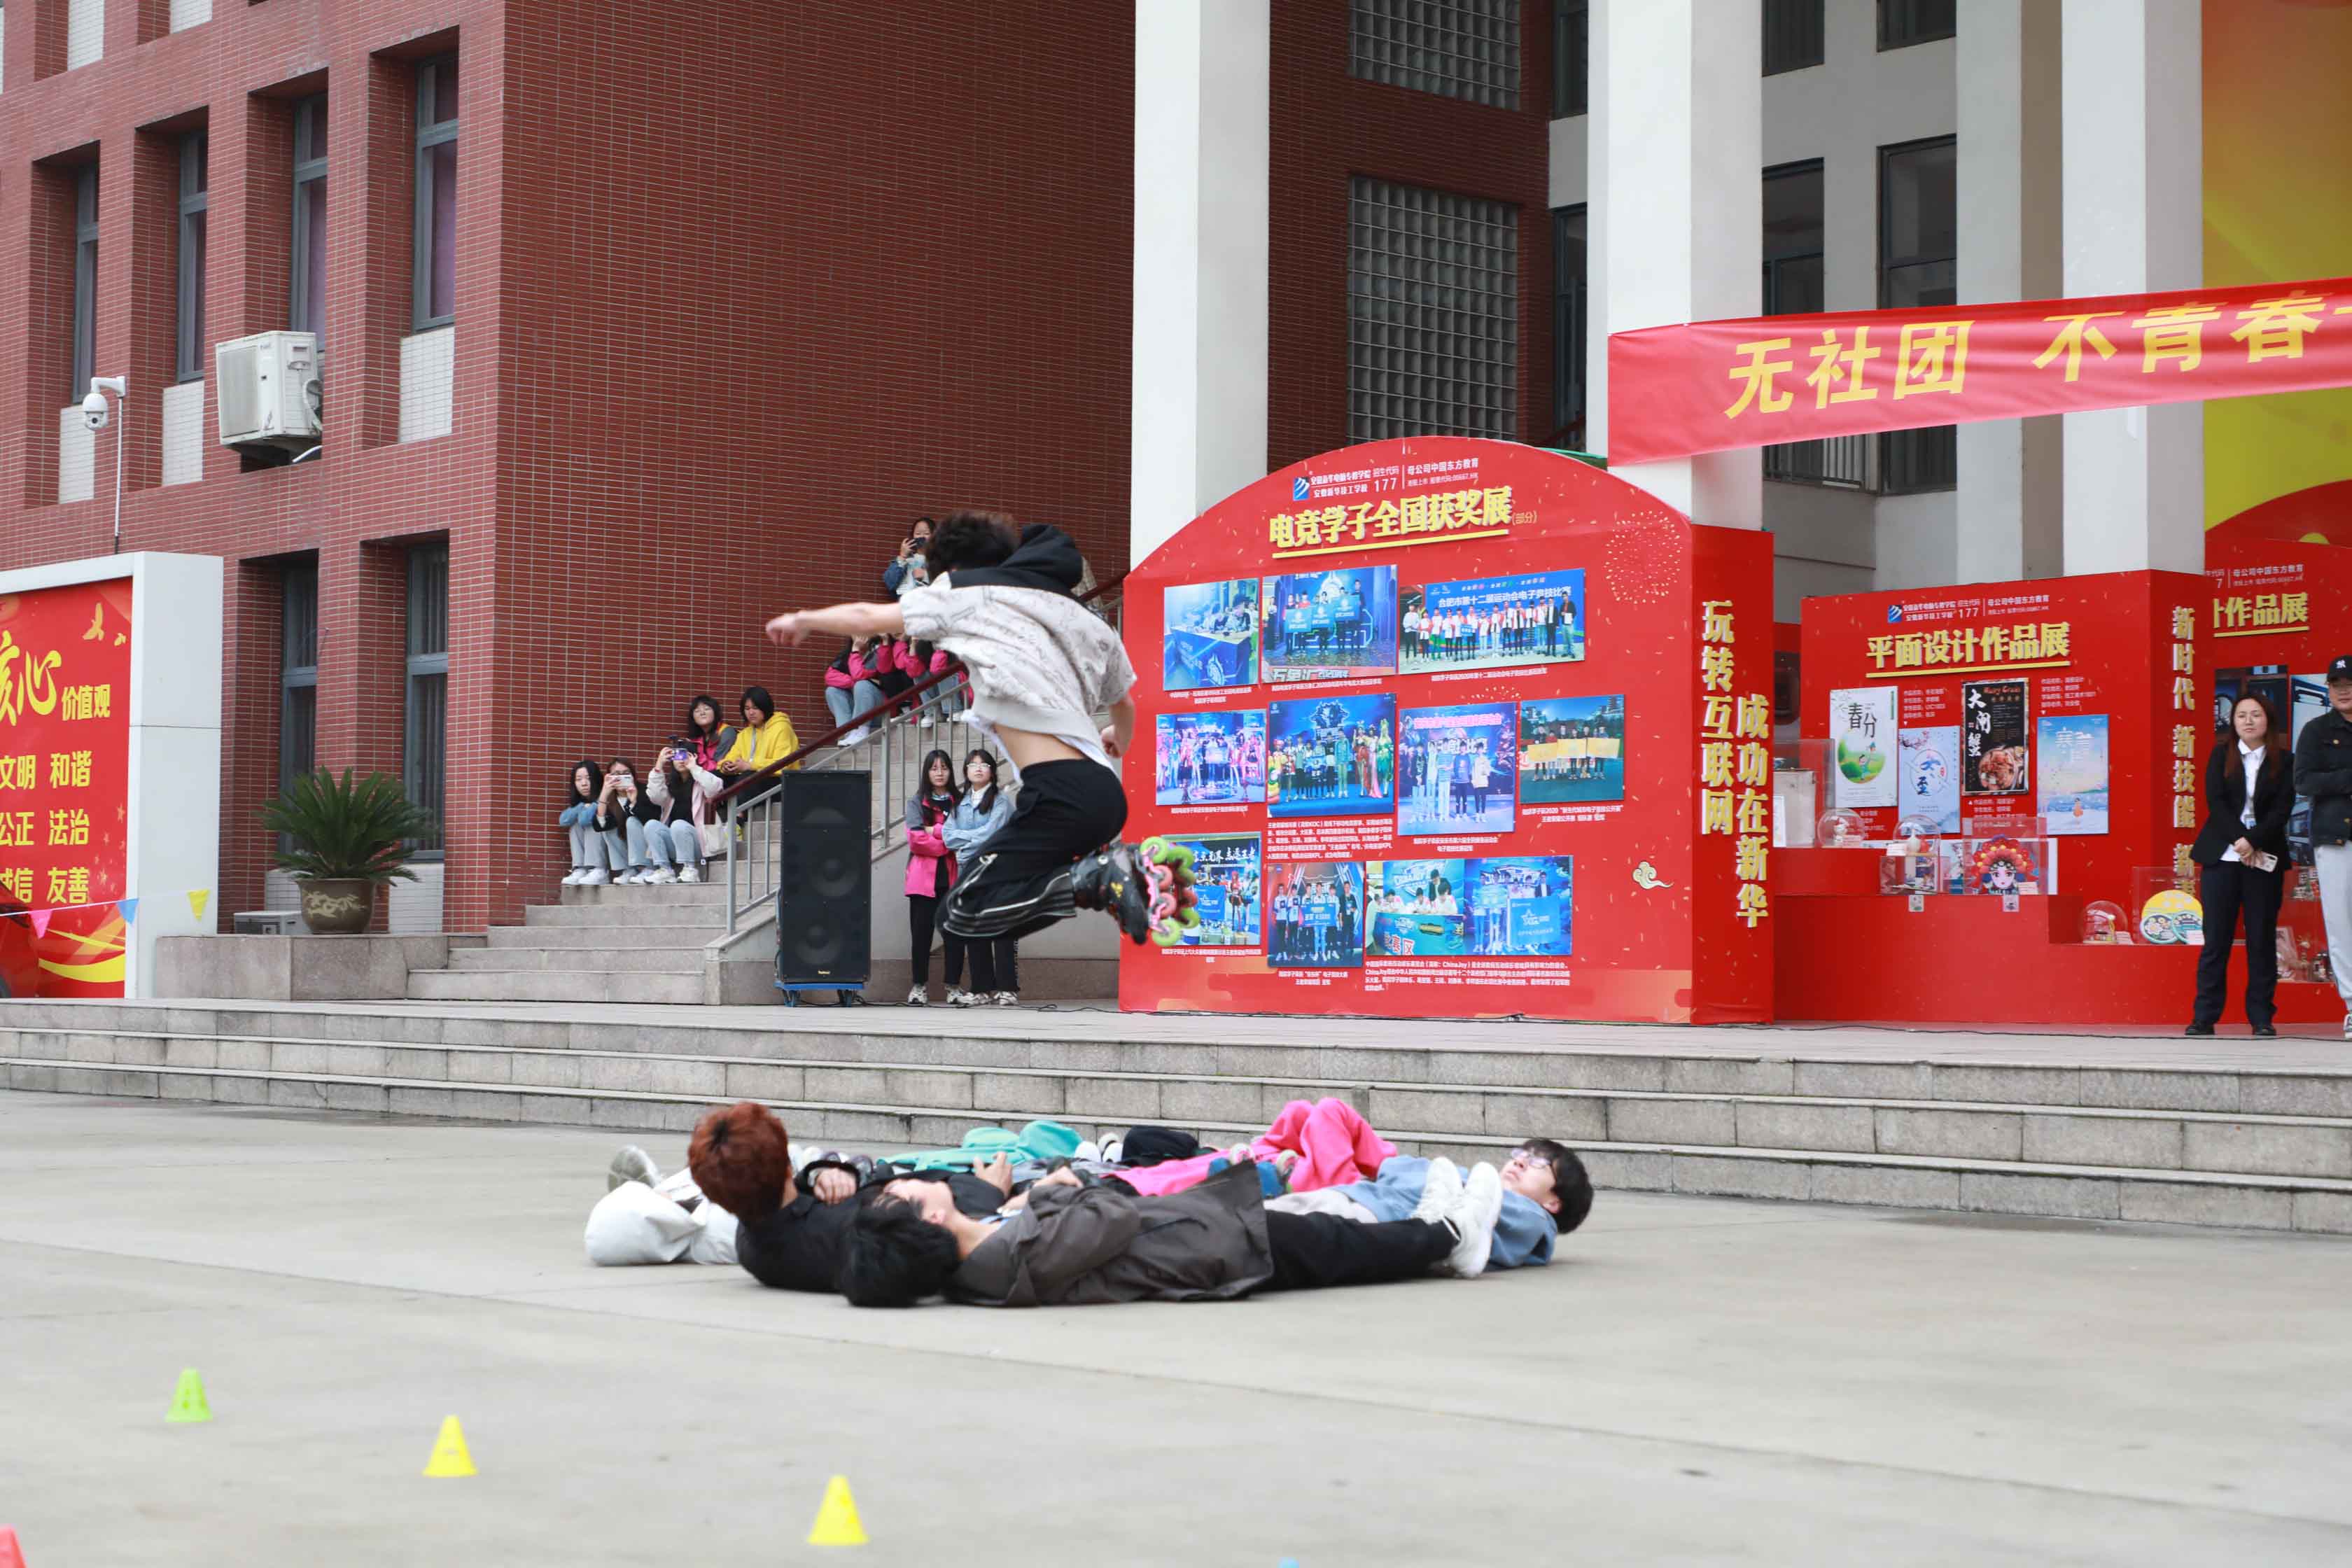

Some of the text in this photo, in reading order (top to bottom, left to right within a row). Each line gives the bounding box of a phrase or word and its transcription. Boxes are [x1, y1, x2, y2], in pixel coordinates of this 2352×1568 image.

[1724, 290, 2352, 419] 无社团 不青春
[1374, 477, 1397, 492] 177
[1408, 458, 1478, 475] 母公司中国东方教育
[1270, 486, 1513, 548] 电竞学子全国获奖展
[1958, 608, 1979, 619] 177
[1866, 622, 2070, 669] 平面设计作品展
[2172, 606, 2195, 710] 新时代
[62, 684, 111, 721] 价值观
[1701, 599, 1735, 836] 玩转互联网
[1848, 703, 1877, 738] 春分
[0, 750, 92, 790] 文明 和谐
[2172, 724, 2196, 828] 新技能
[0, 808, 90, 846] 公正 法治
[1735, 694, 1769, 928] 成功在新华
[47, 866, 90, 904] 友善
